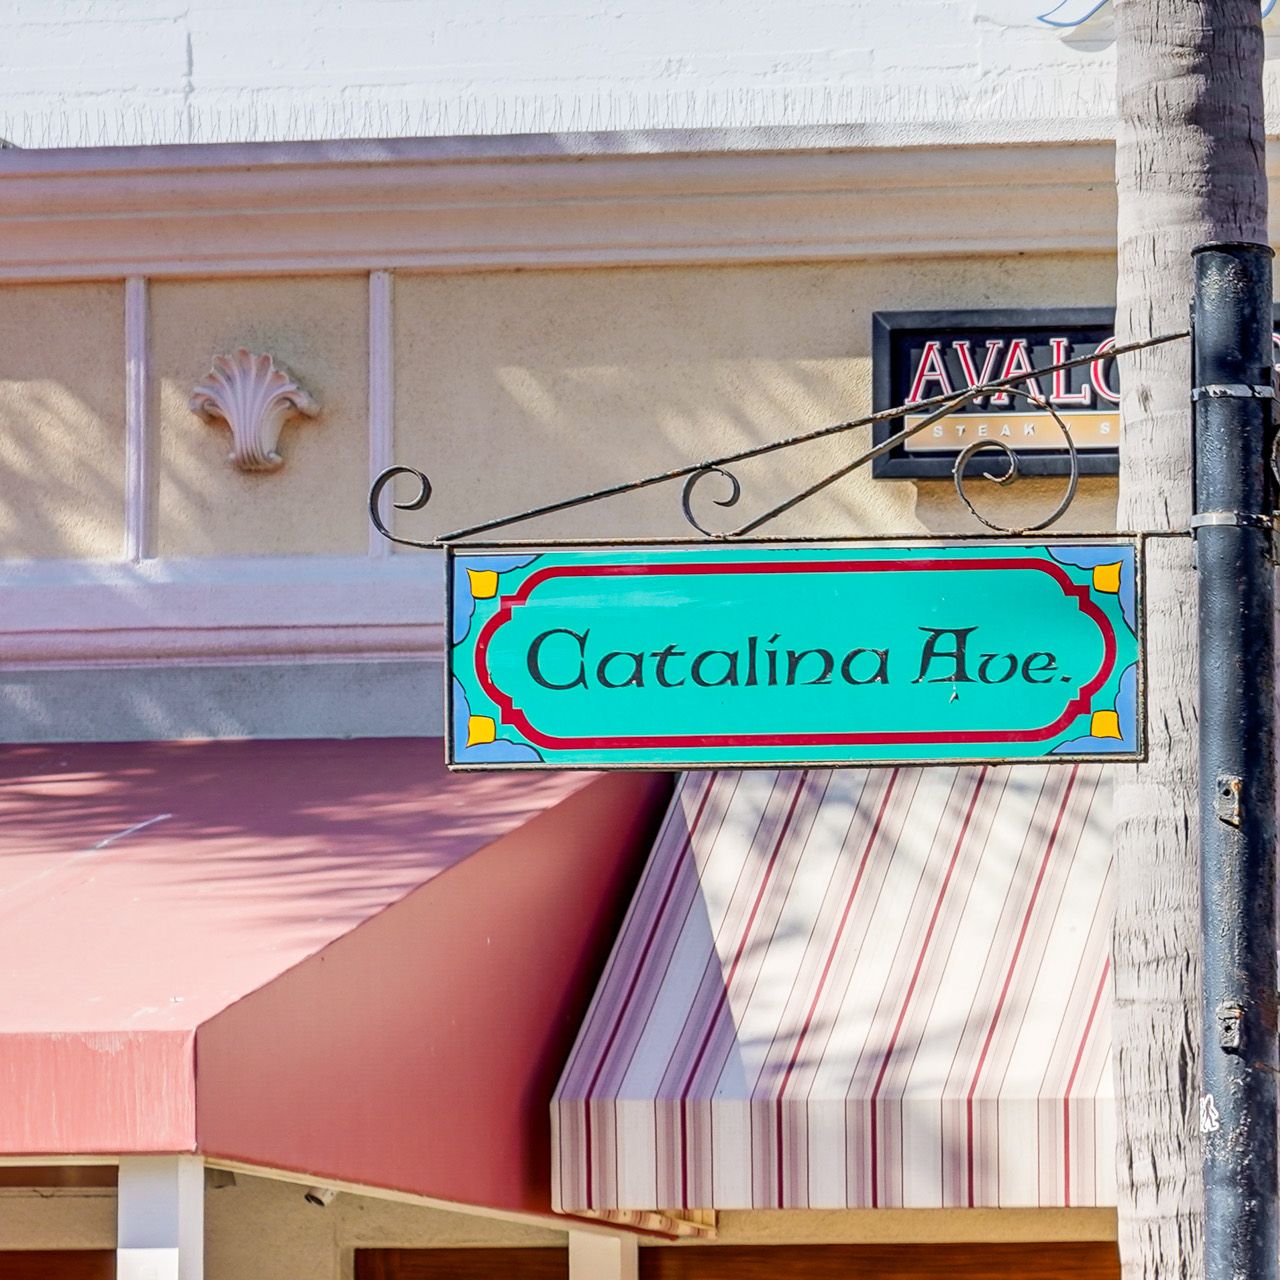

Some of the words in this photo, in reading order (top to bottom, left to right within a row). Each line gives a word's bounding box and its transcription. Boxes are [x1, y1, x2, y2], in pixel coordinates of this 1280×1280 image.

[905, 335, 1121, 406] AVALO
[933, 422, 1036, 437] STEAK
[526, 627, 890, 691] Catalina
[911, 625, 1073, 686] Ave.
